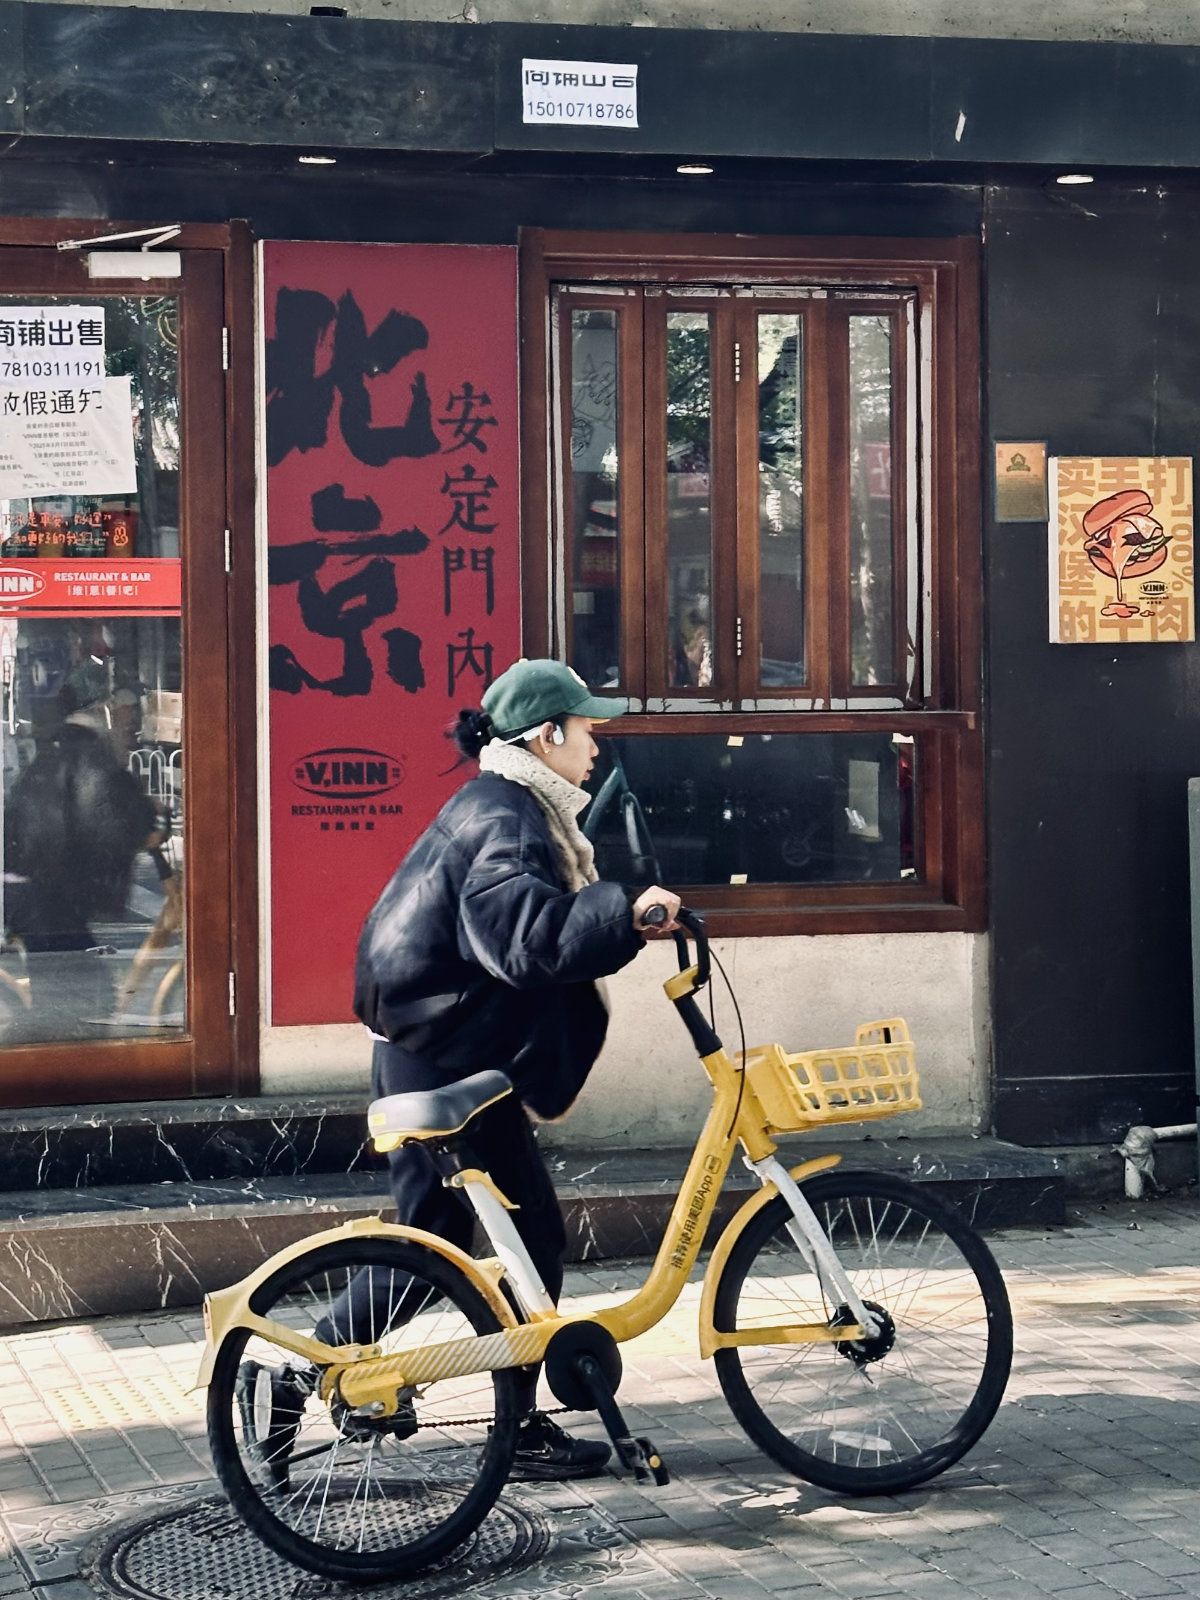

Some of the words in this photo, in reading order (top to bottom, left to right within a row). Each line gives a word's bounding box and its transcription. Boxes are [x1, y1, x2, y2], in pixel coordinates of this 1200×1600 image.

[528, 102, 634, 118] 15010718786
[2, 362, 100, 376] 7810311191
[266, 285, 441, 696] 北京
[54, 572, 118, 582] RESTAURANT
[121, 572, 128, 581] &
[130, 572, 151, 581] BAR
[438, 381, 500, 777] 安定門內
[291, 805, 366, 816] RESTAURANT
[369, 804, 377, 815] &
[380, 804, 403, 815] BAR
